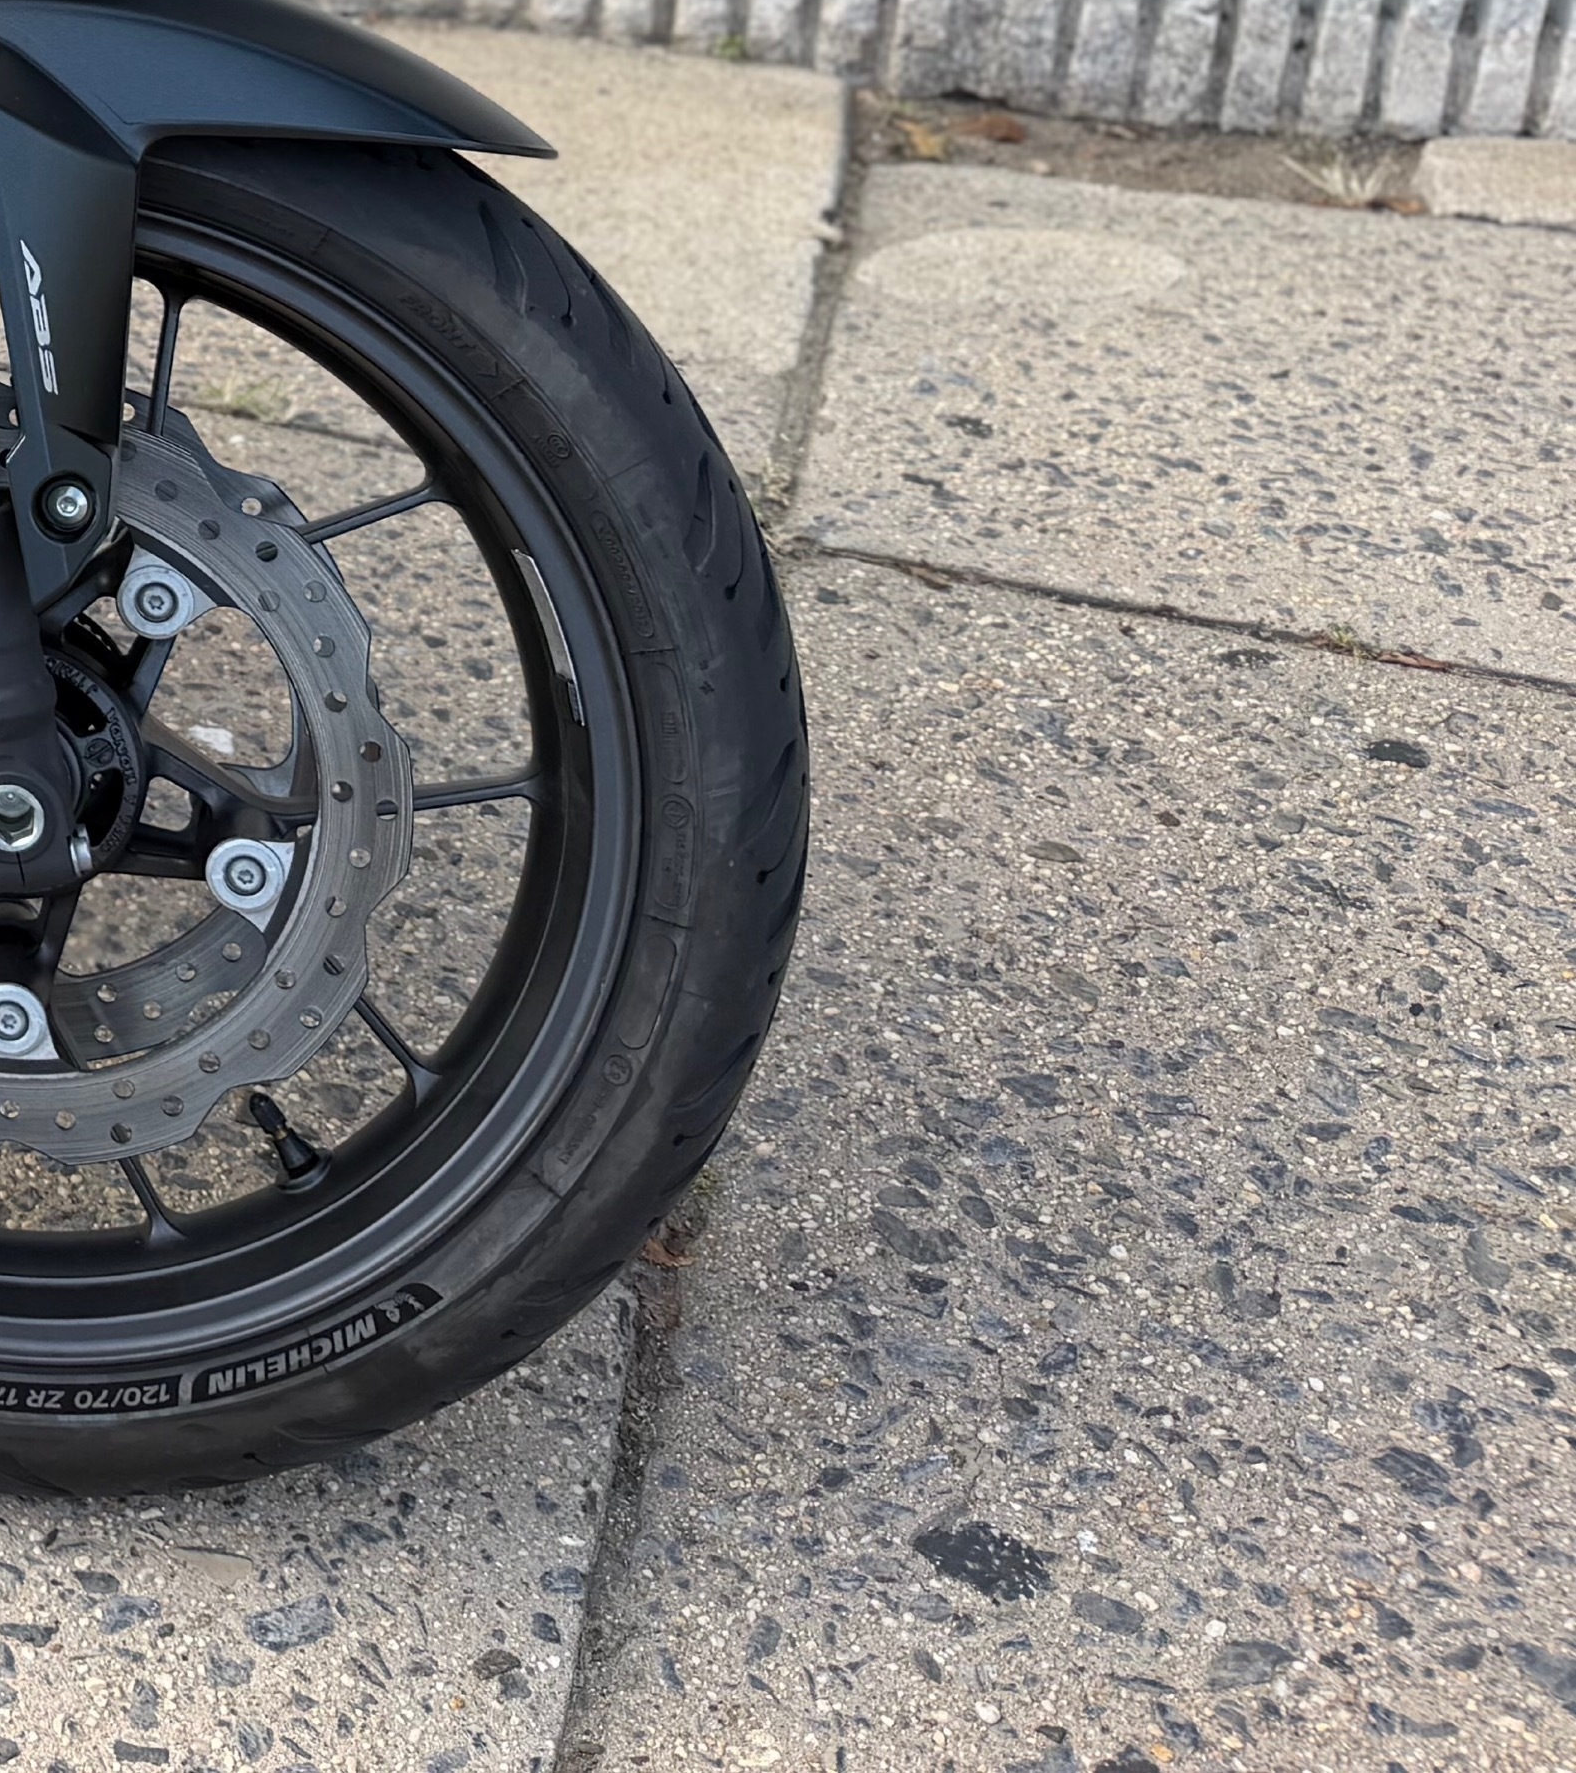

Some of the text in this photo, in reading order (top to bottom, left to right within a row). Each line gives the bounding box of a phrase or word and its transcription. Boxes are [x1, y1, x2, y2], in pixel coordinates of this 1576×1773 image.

[19, 238, 60, 397] ABS
[104, 707, 137, 786] HONDA
[73, 1382, 171, 1411] 120/70
[207, 1316, 378, 1398] MICHELIN
[26, 1387, 62, 1410] ZR
